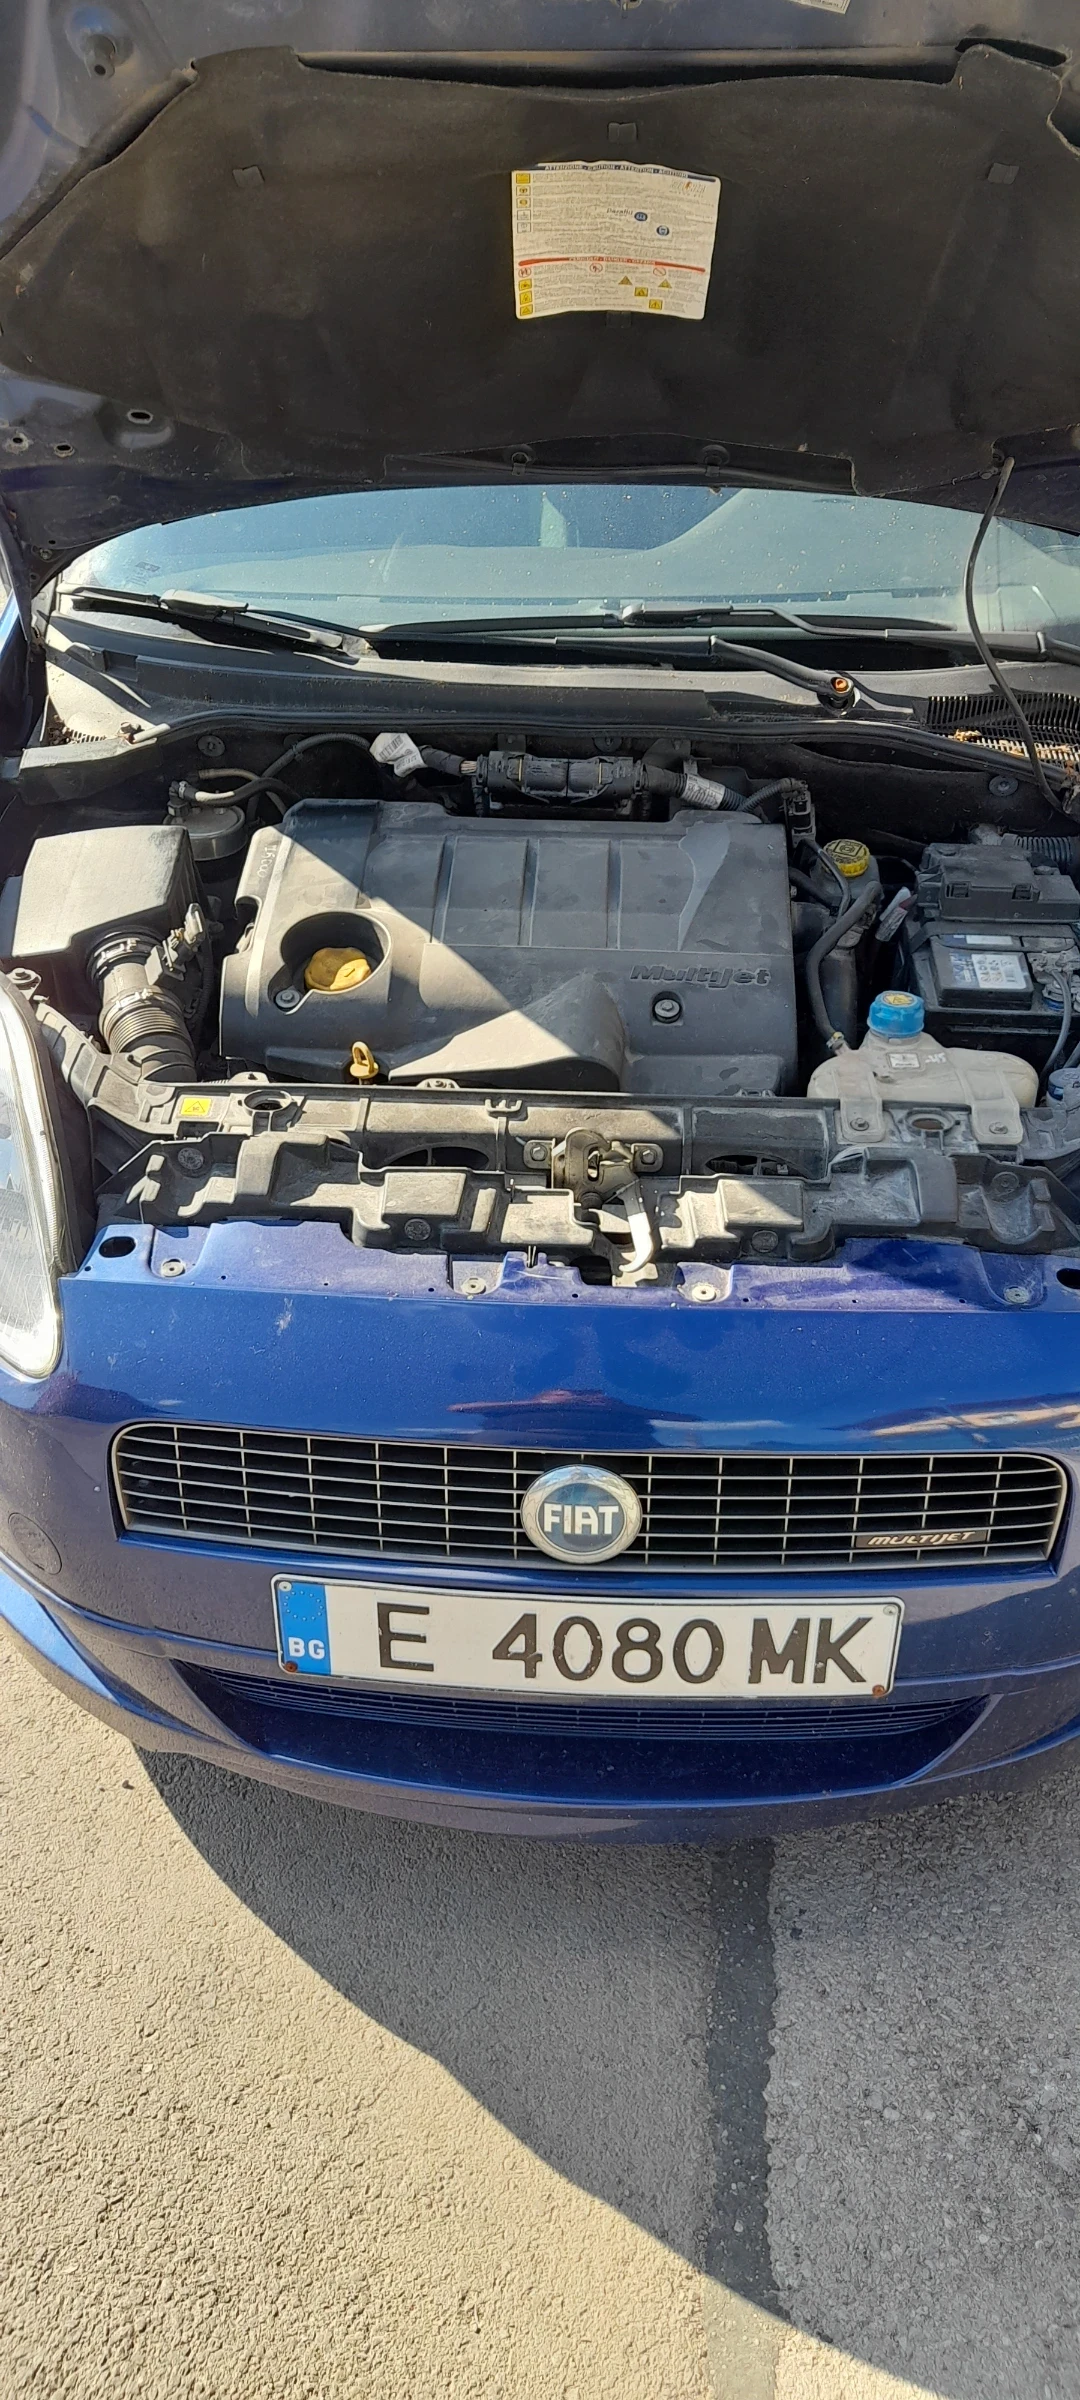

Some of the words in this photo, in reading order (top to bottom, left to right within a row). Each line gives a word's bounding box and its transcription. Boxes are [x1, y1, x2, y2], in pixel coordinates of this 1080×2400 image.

[543, 1502, 619, 1535] FIAT
[867, 1531, 976, 1545] MULTIJET
[288, 1637, 326, 1660] BG
[376, 1601, 435, 1672] E
[492, 1612, 725, 1685] 4080
[747, 1616, 873, 1685] MK
